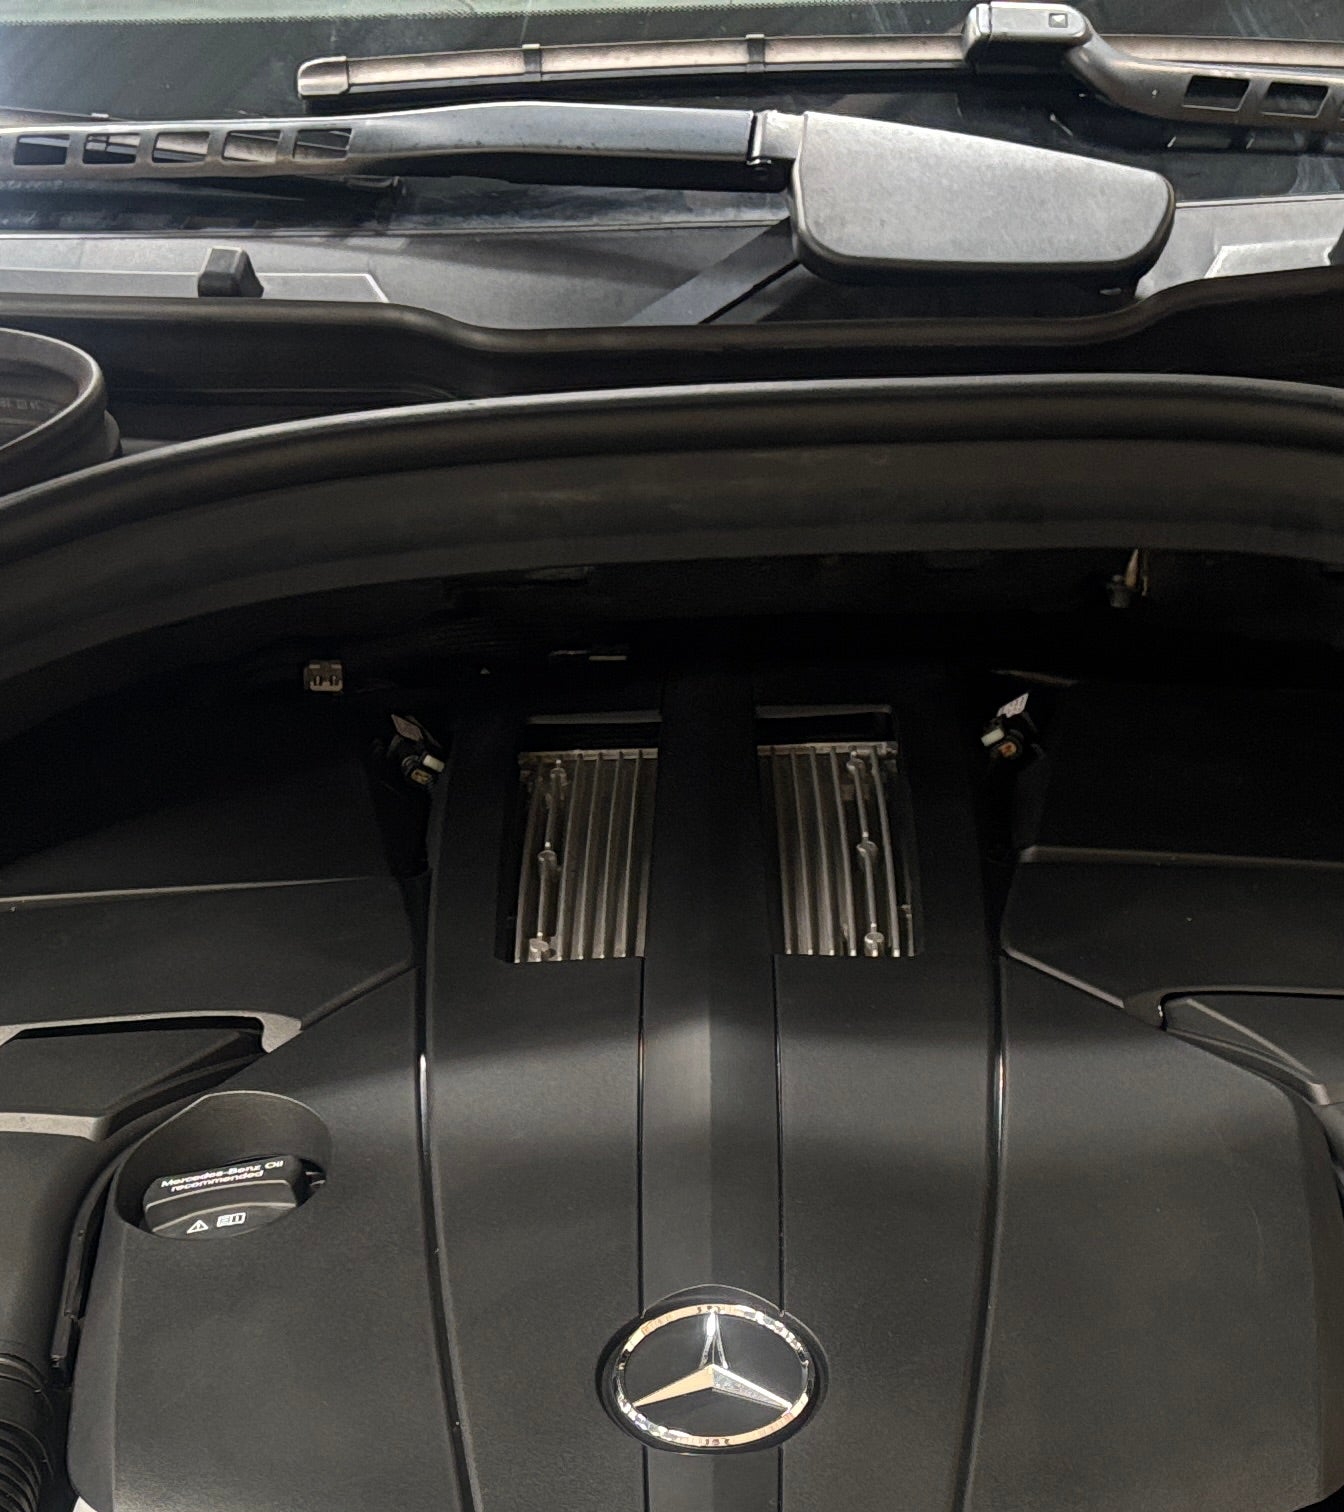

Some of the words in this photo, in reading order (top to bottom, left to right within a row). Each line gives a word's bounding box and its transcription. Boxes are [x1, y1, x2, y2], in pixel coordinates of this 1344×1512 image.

[160, 1163, 262, 1188] Mercedes-Benz
[264, 1159, 284, 1170] Oil
[170, 1169, 264, 1192] recommended
